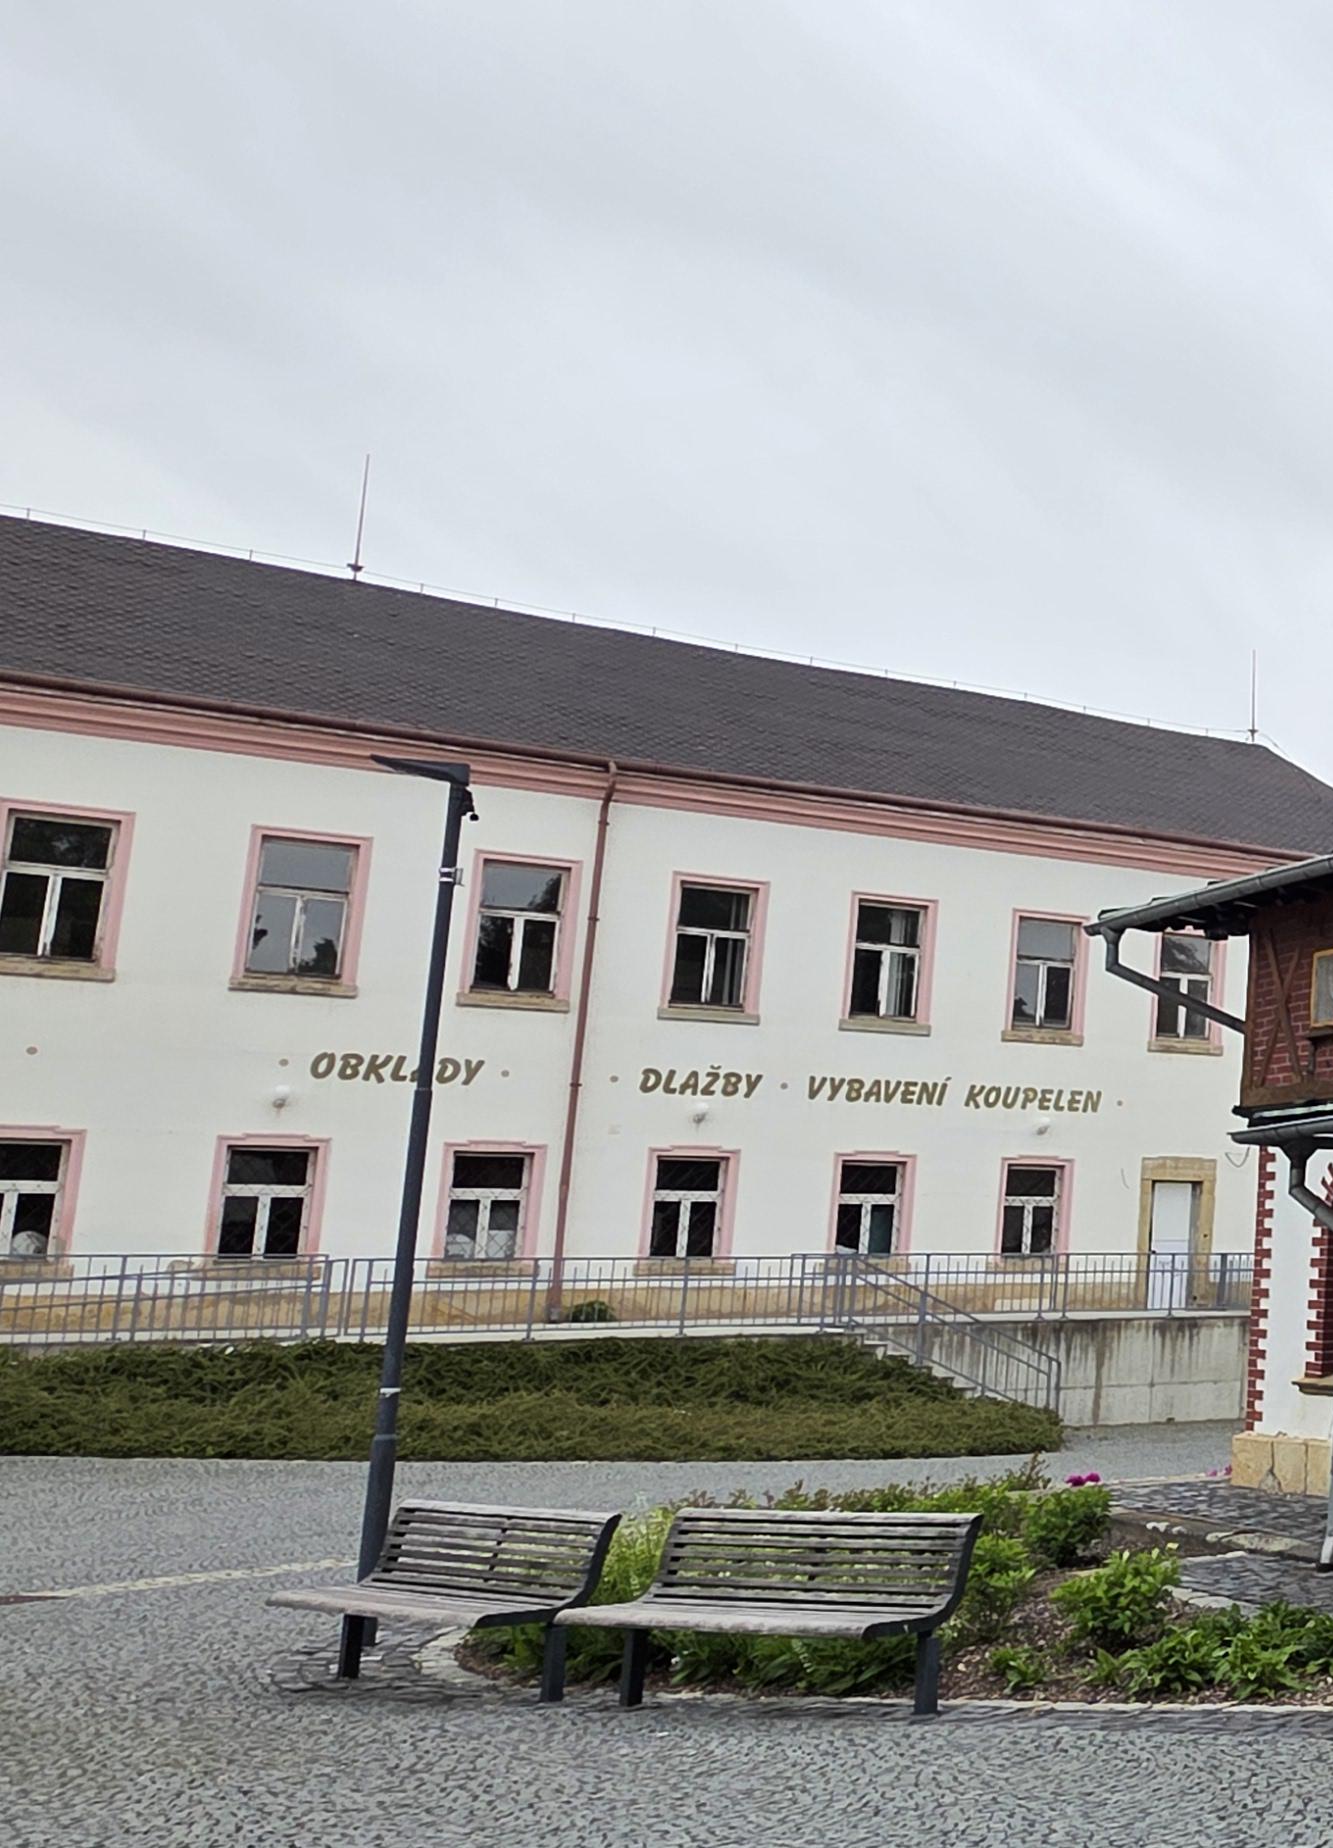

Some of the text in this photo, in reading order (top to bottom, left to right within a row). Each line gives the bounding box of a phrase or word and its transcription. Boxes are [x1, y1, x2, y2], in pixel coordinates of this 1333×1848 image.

[310, 1052, 486, 1086] OBKLDY
[638, 1064, 1102, 1114] DLAŽBY VYBAVENÍ KOUPELEN
